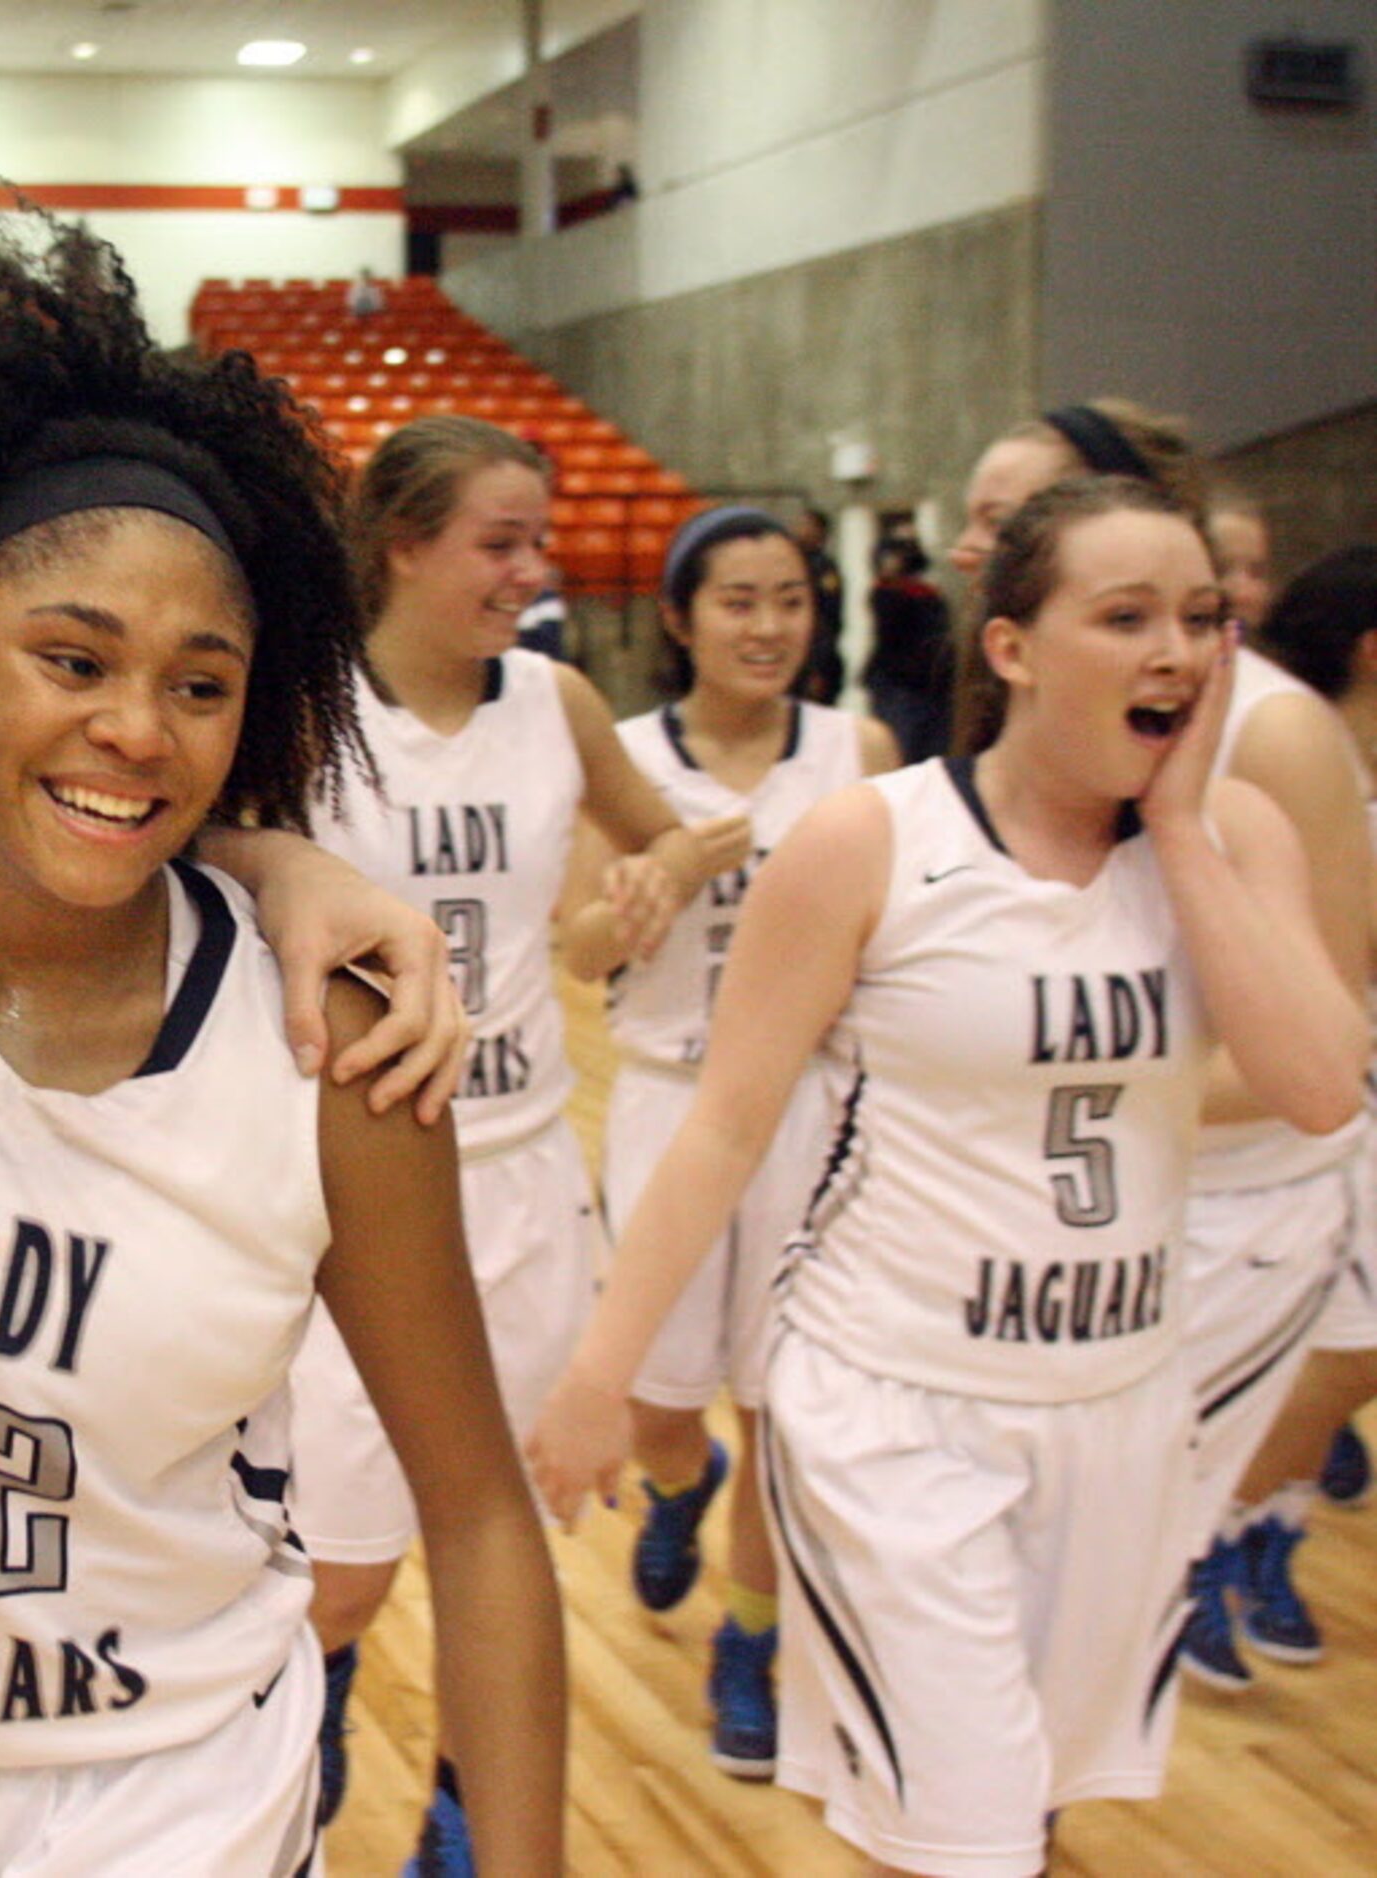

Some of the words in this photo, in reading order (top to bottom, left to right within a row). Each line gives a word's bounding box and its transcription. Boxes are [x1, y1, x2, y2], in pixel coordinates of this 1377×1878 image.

[410, 804, 508, 875] LADY
[1029, 969, 1169, 1065] LADY
[1043, 1082, 1127, 1228] 5
